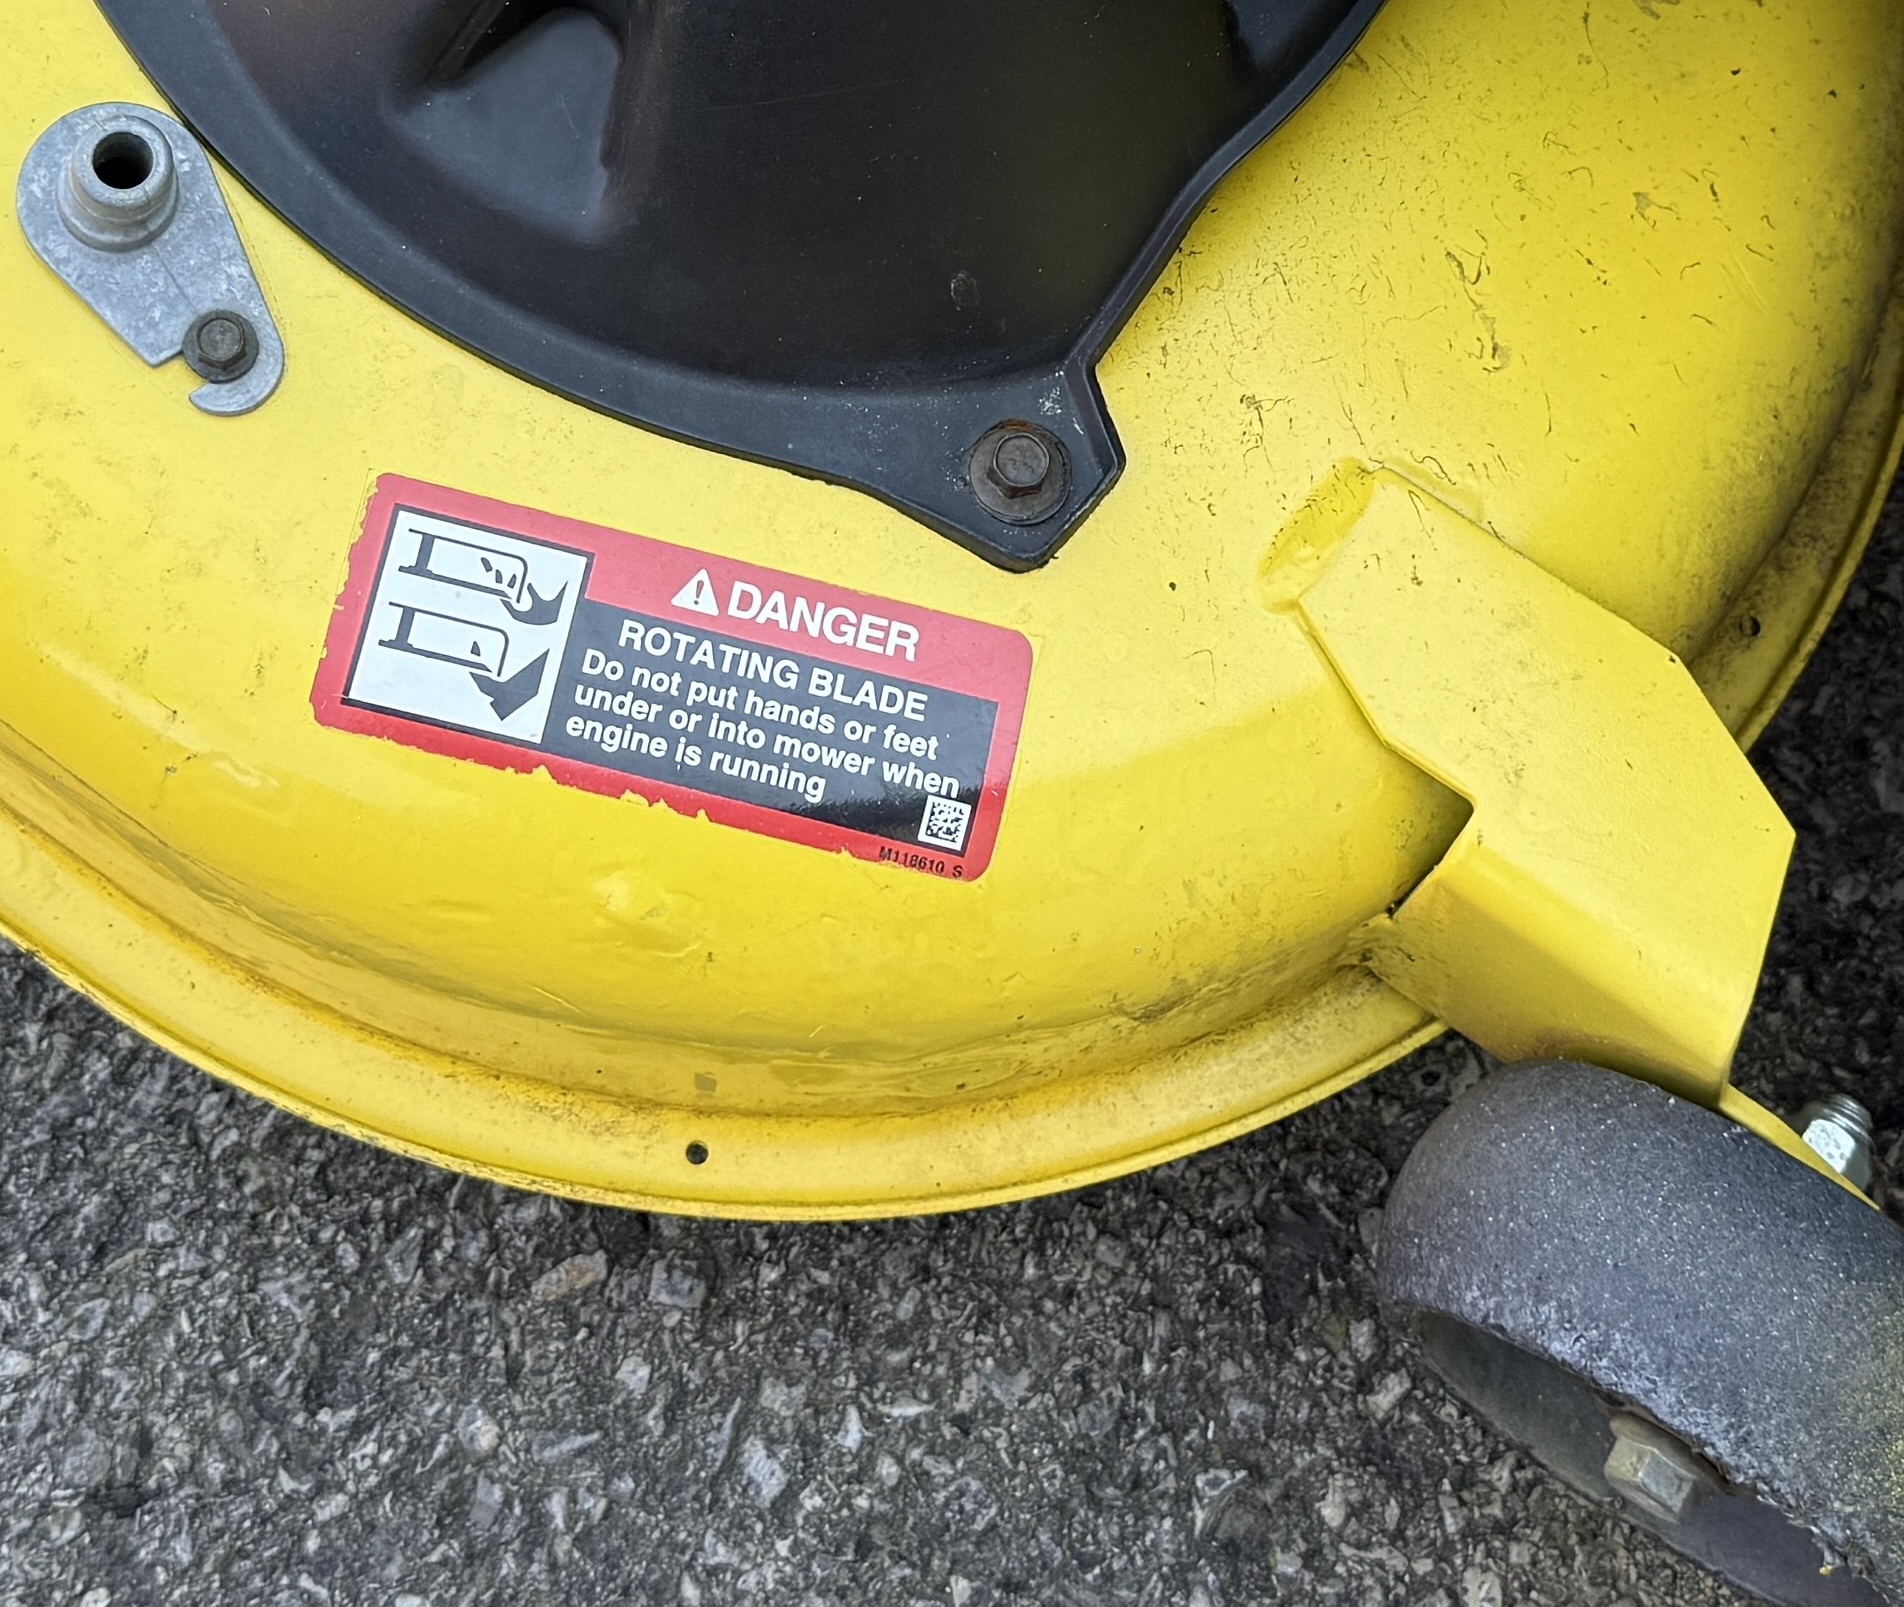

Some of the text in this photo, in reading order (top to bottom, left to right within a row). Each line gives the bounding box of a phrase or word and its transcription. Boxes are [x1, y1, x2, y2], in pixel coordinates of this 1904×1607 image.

[618, 619, 928, 722] ROTATING BLADE
[727, 580, 920, 662] DANGER
[574, 684, 960, 798] under or into mower when
[582, 648, 939, 761] Do not put hands or feet
[565, 715, 826, 804] engine is running
